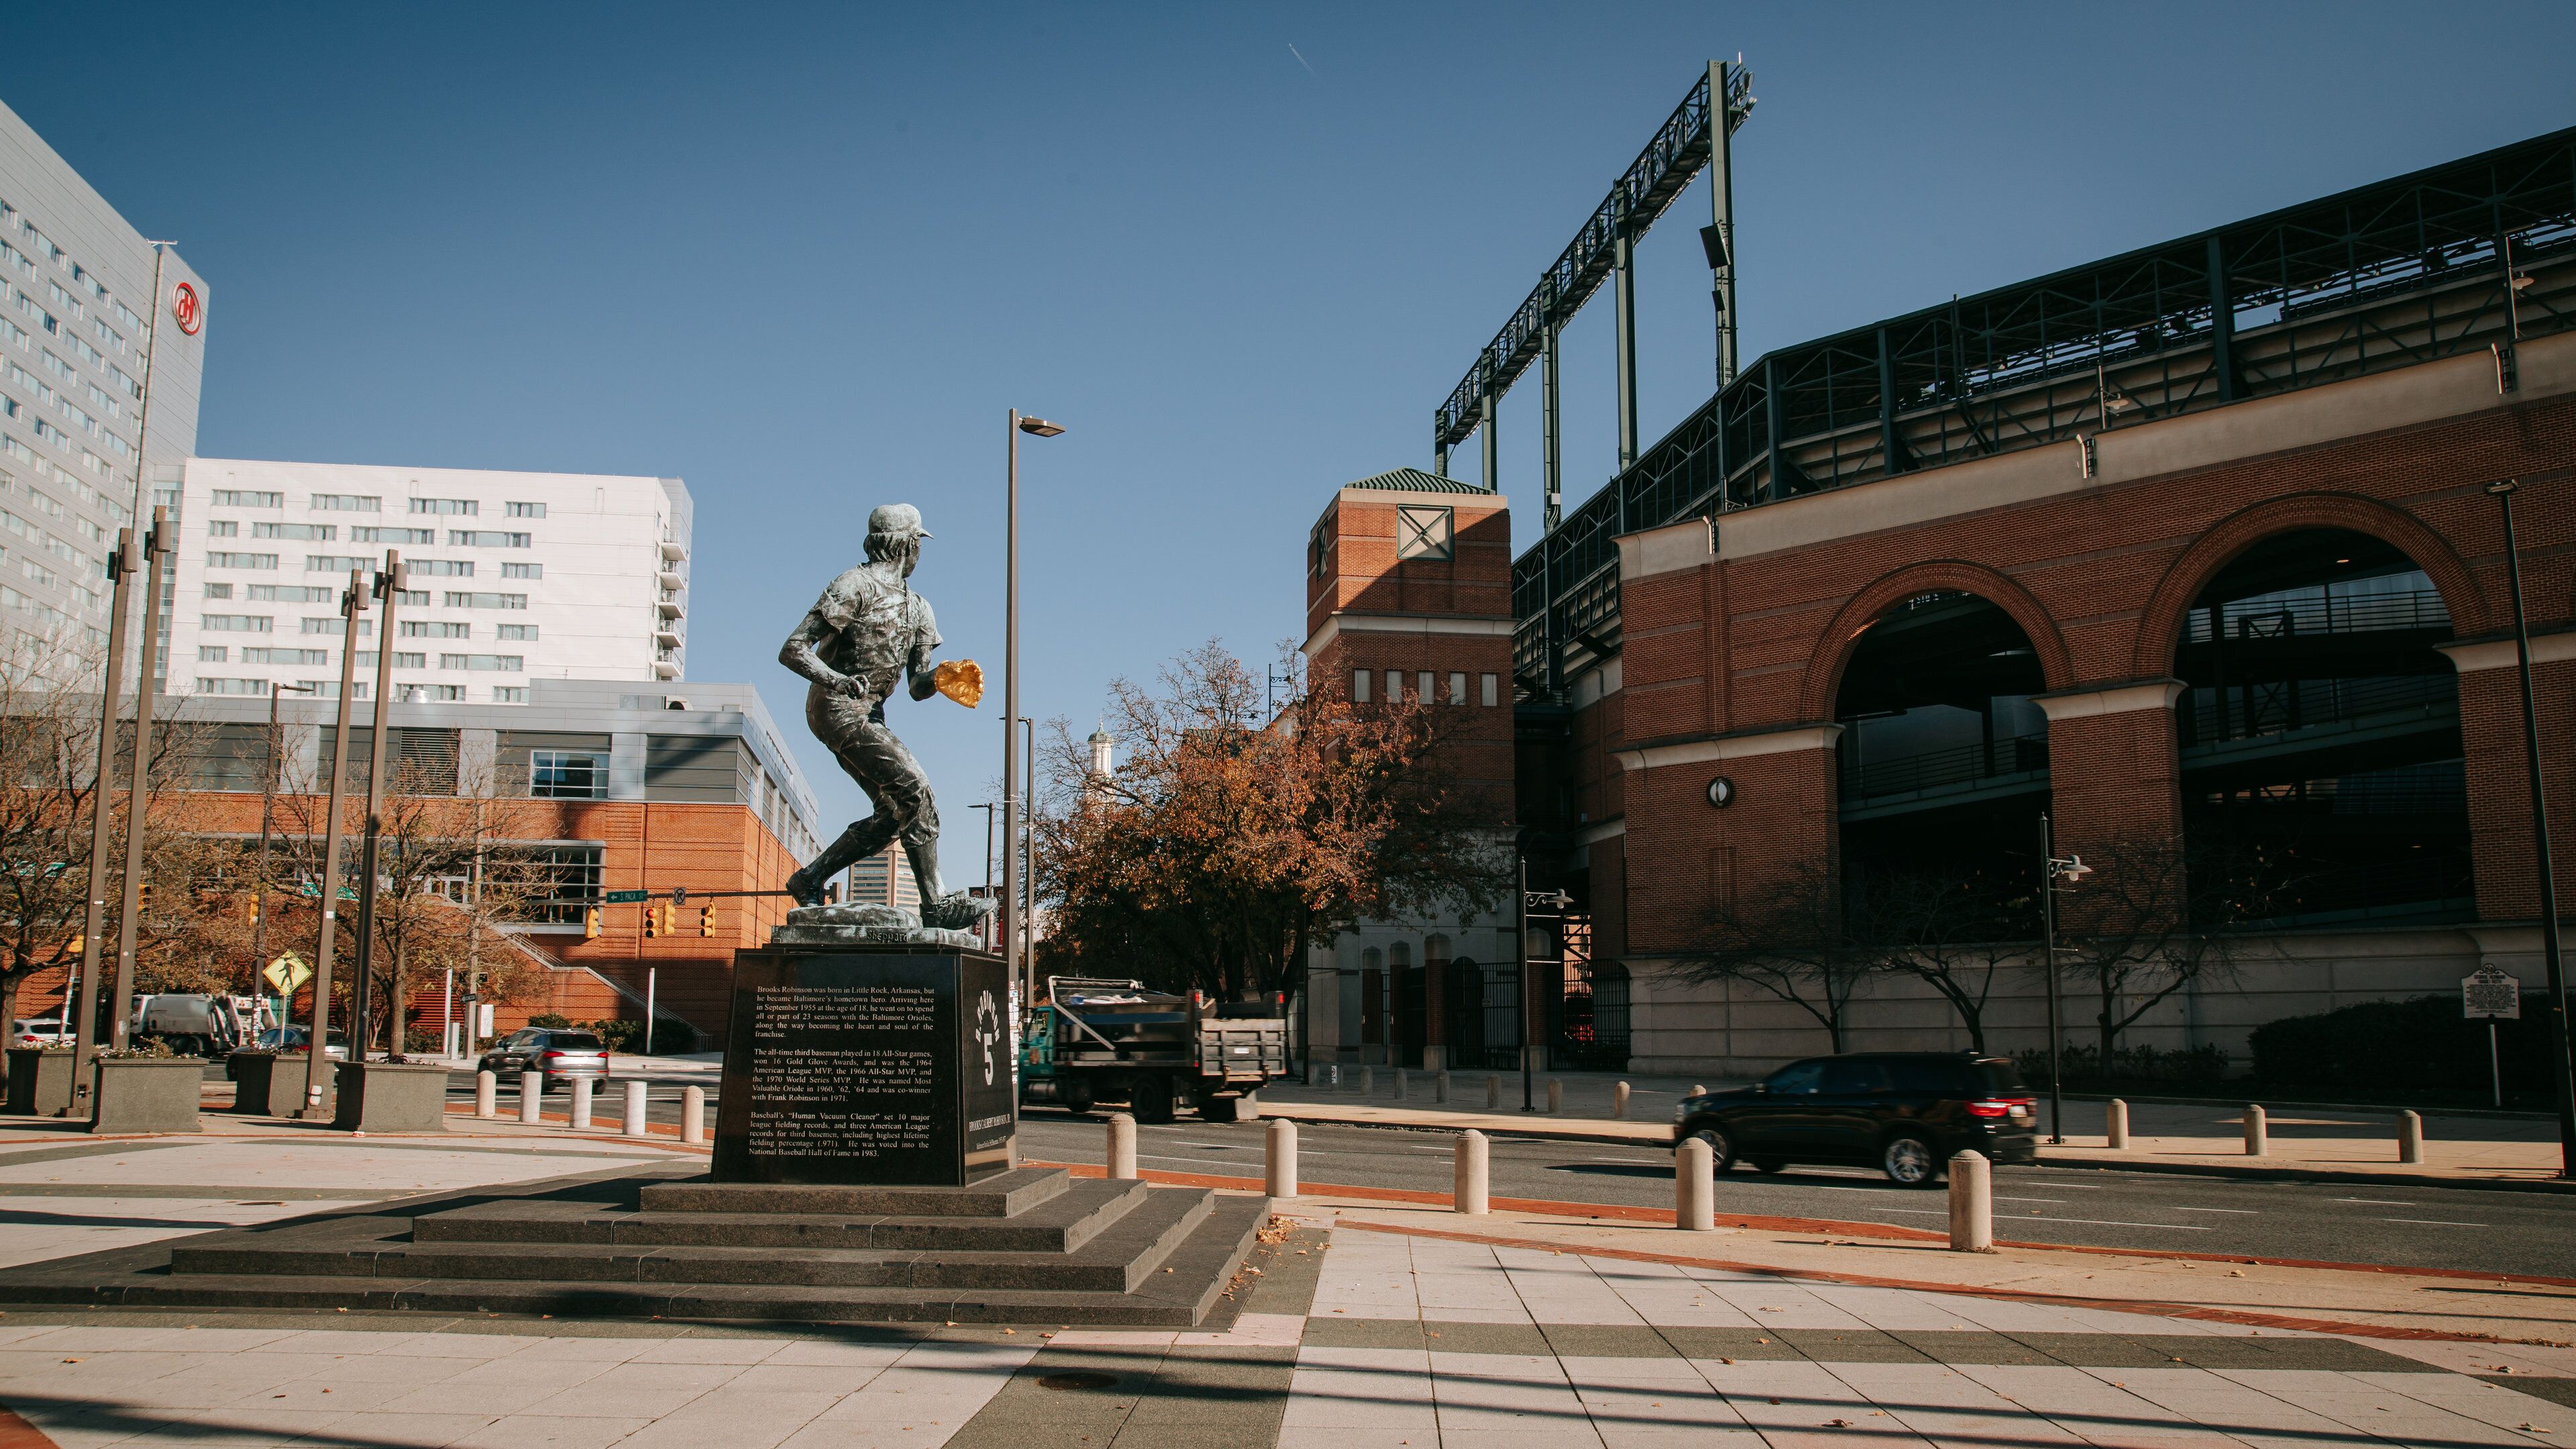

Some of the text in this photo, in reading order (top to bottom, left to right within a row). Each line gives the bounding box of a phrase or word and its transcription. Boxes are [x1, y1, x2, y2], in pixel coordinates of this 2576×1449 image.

[621, 893, 623, 901] S
[625, 892, 636, 900] PACA
[867, 930, 909, 943] Sheppard
[871, 987, 890, 995] Rock,
[890, 996, 918, 1004] Arriving
[765, 1004, 798, 1012] September
[915, 1005, 934, 1014] spend
[755, 1022, 773, 1030] along
[808, 1022, 840, 1030] becoming
[841, 1050, 863, 1058] played
[983, 1033, 994, 1085] 5
[788, 1067, 812, 1075] League
[751, 1120, 771, 1129] league
[775, 1121, 800, 1129] fielding
[906, 1123, 930, 1131] League
[843, 1131, 873, 1140] including
[877, 1132, 900, 1140] highest
[749, 1139, 774, 1147] fielding
